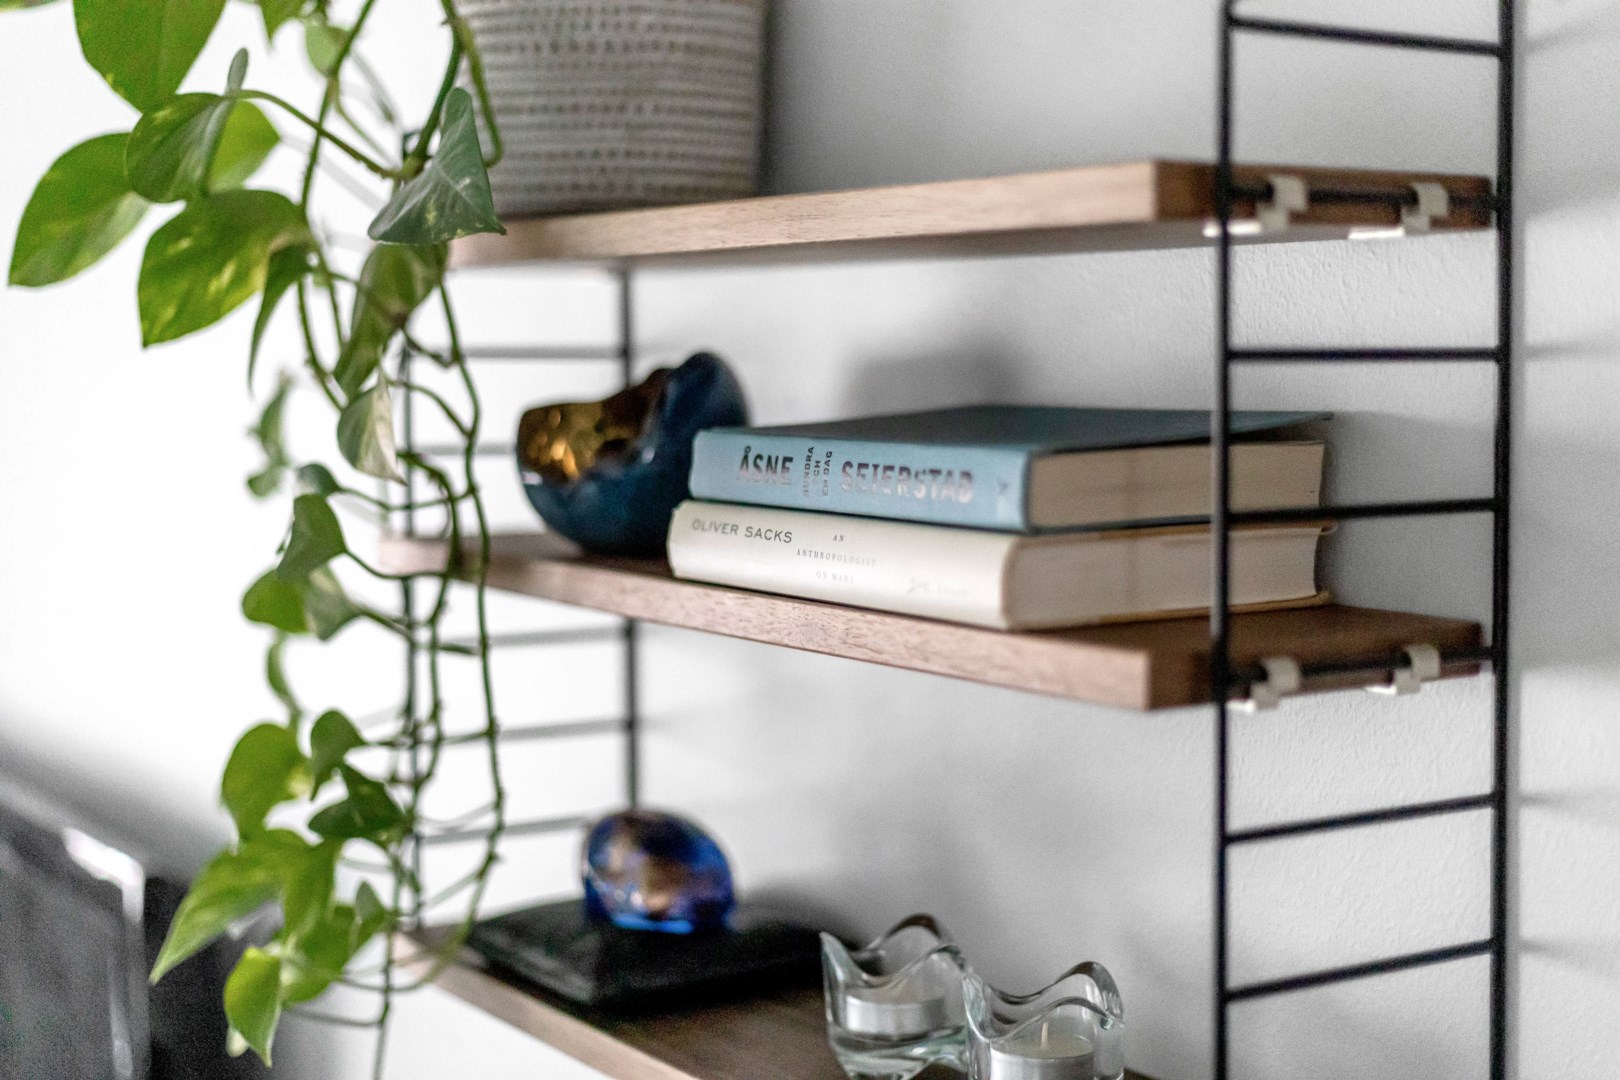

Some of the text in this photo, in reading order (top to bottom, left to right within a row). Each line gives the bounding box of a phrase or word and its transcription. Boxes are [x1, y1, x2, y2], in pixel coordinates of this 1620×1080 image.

[738, 445, 794, 486] ÅSNE
[823, 450, 833, 476] DAG
[841, 460, 973, 503] SEIERSTAD
[692, 518, 793, 544] OLIVER SACKS
[832, 533, 845, 543] AN
[796, 548, 877, 566] ANTHROPOLOGIST
